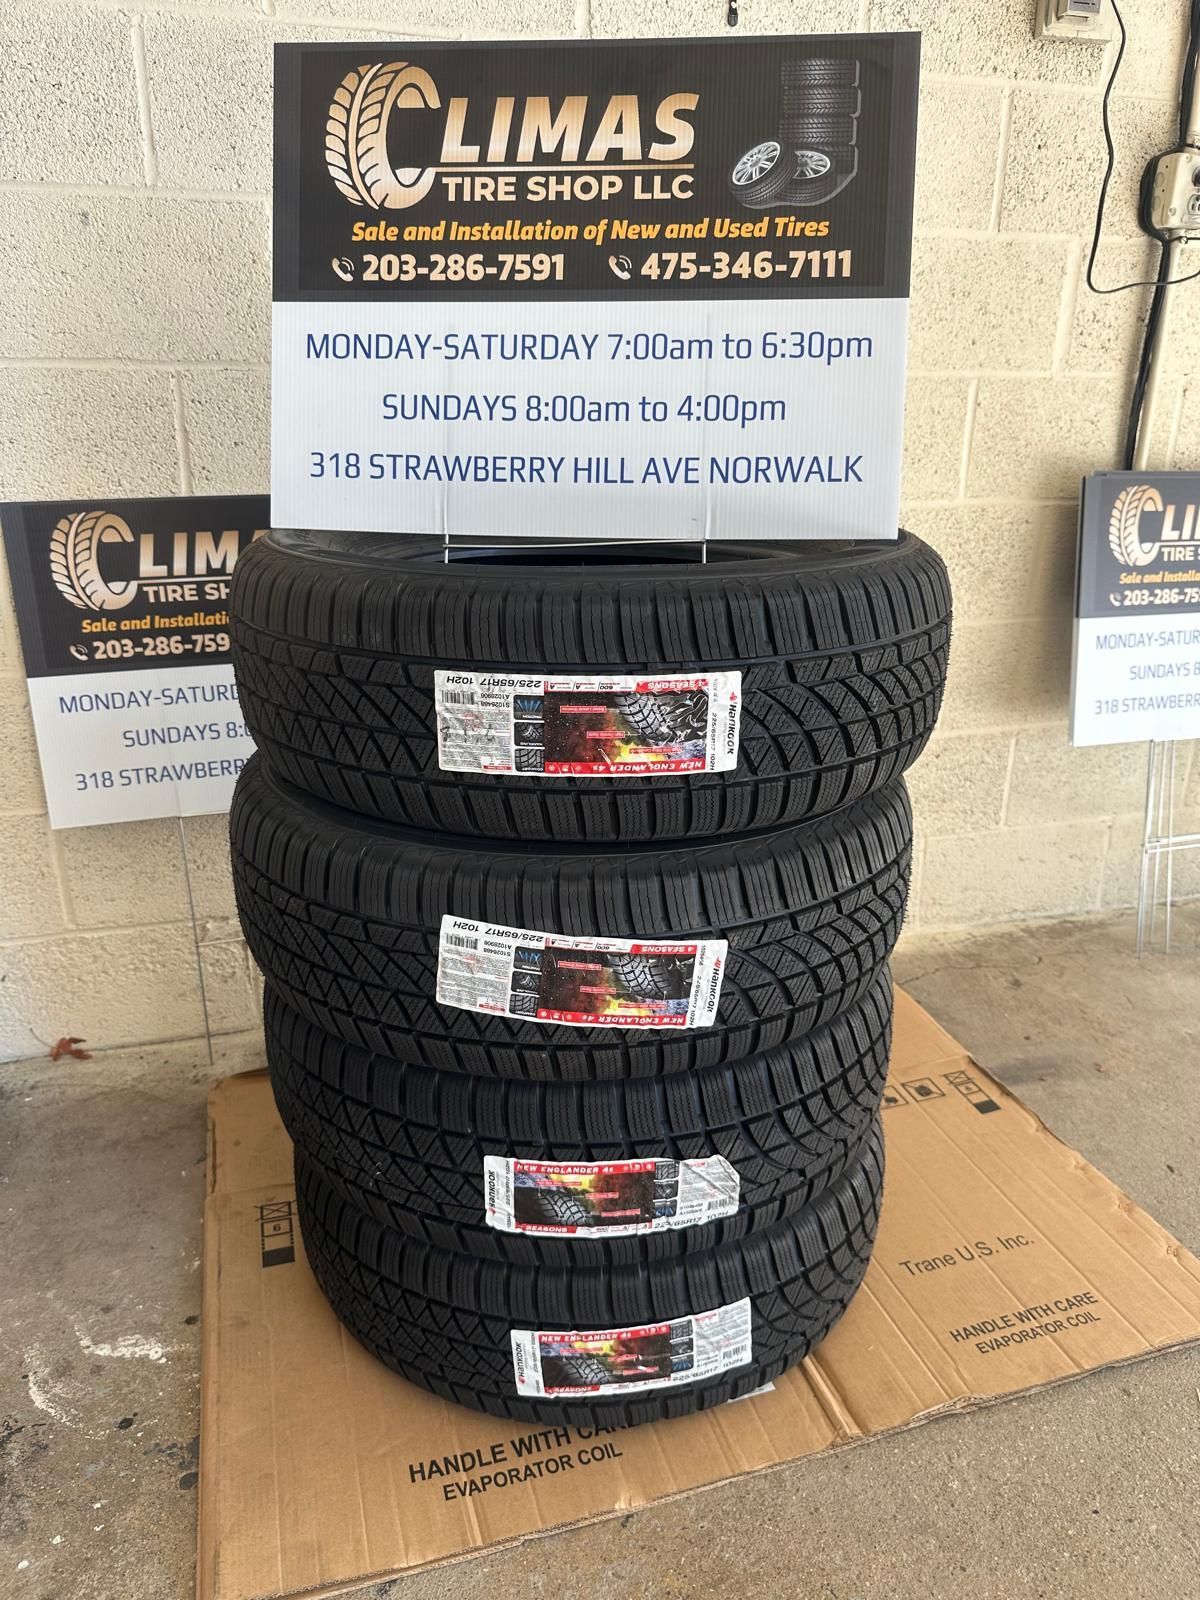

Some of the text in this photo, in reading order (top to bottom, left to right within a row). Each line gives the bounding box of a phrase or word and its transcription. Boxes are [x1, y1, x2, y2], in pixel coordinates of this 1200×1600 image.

[325, 62, 699, 208] CLIMAS
[443, 174, 694, 203] TIRE SHOP LLC
[352, 216, 829, 246] Sale and Installation of New and Used Tires
[363, 250, 851, 282] 203-286-7591 475-346-7111
[306, 332, 872, 365] MONDAY-SATURDAY 7:00am to 6:30pm
[382, 394, 786, 428] SUNDAYS 8:00am to 4:00pm
[310, 451, 863, 484] 318 STRAWBERRY HILL AVE NORWALK
[1109, 485, 1200, 567] CLI
[1162, 548, 1194, 561] TIRE
[1120, 572, 1141, 584] Sale
[1144, 571, 1161, 583] and
[143, 583, 199, 603] TIRE
[1124, 589, 1200, 606] 203-286-75
[82, 612, 229, 633] Sale and Installati
[446, 675, 542, 688] 225/65R17 102H
[1130, 663, 1190, 680] SUNDAYS
[648, 681, 697, 689] SEASONS
[1095, 699, 1118, 715] 318
[124, 722, 220, 747] SUNDAYS
[610, 763, 675, 772] ENGLANDER
[679, 761, 702, 769] NEW
[76, 771, 114, 790] 318
[453, 921, 544, 942] 225/65R17 102H
[899, 1232, 1035, 1278] Trane U.S. Inc.
[949, 1291, 1098, 1343] HANDLE WITH CARE
[975, 1309, 1101, 1354] EVAPORATOR COIL
[409, 1443, 507, 1483] HANDLE
[510, 1427, 571, 1457] WITH
[443, 1443, 623, 1501] EVAPORATOR COIL
